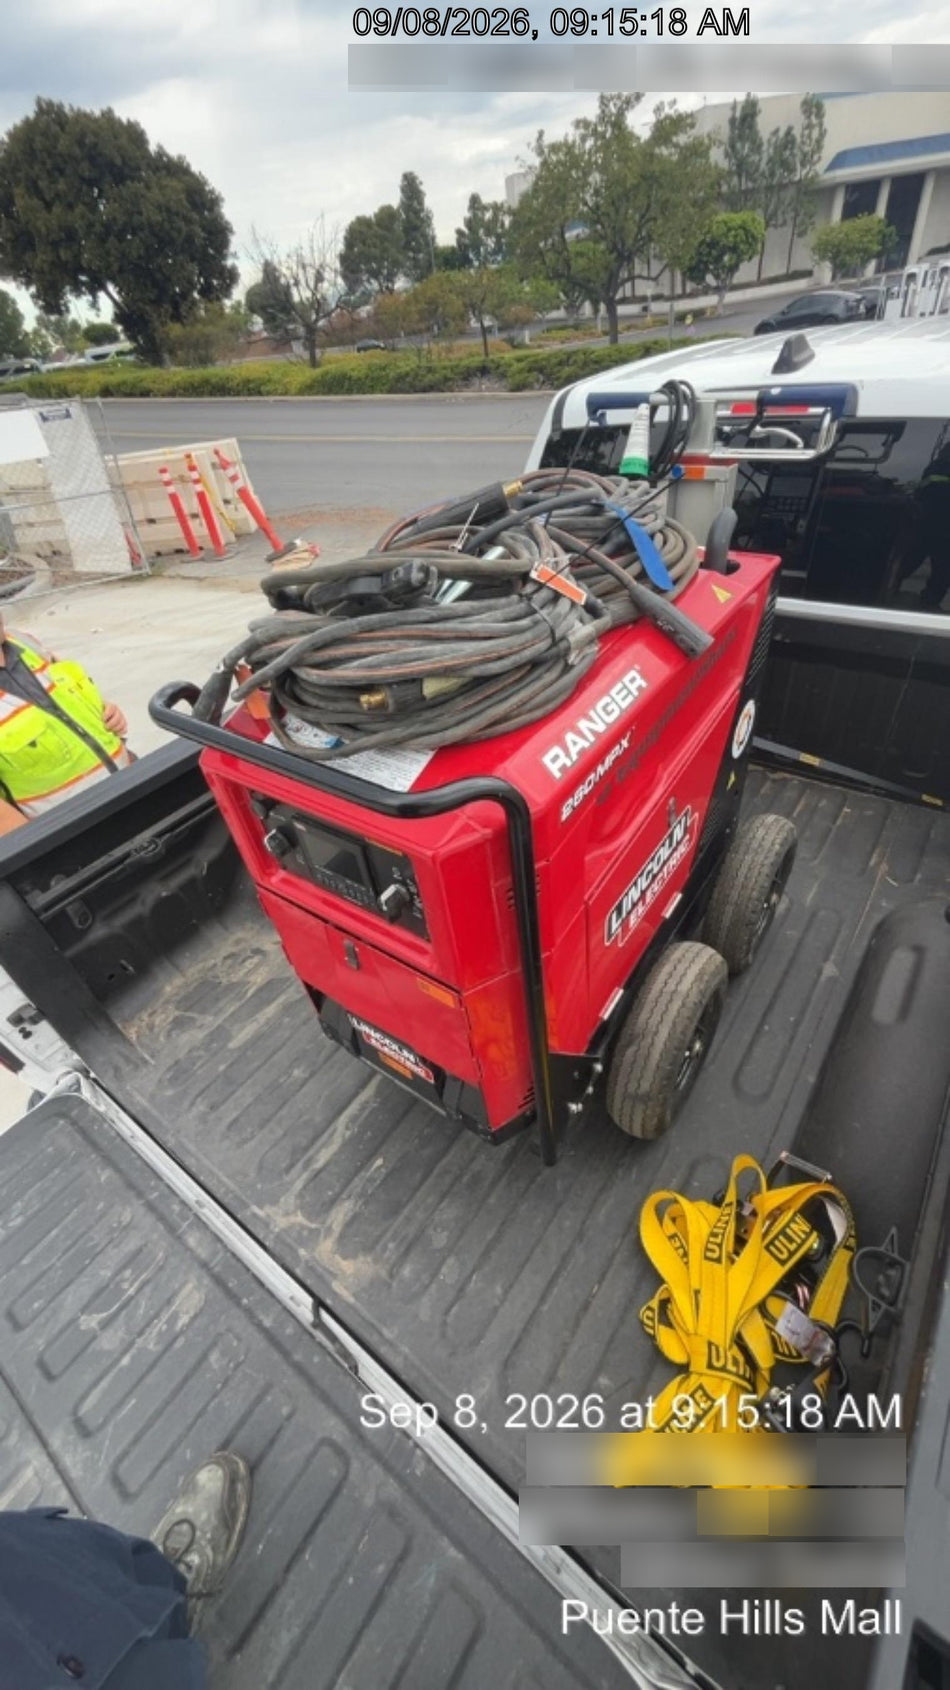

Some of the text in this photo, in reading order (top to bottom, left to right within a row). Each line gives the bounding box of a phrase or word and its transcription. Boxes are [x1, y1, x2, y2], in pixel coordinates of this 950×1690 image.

[541, 668, 648, 779] RANGER
[610, 816, 687, 934] LINCOLN
[769, 1213, 812, 1260] ULIN
